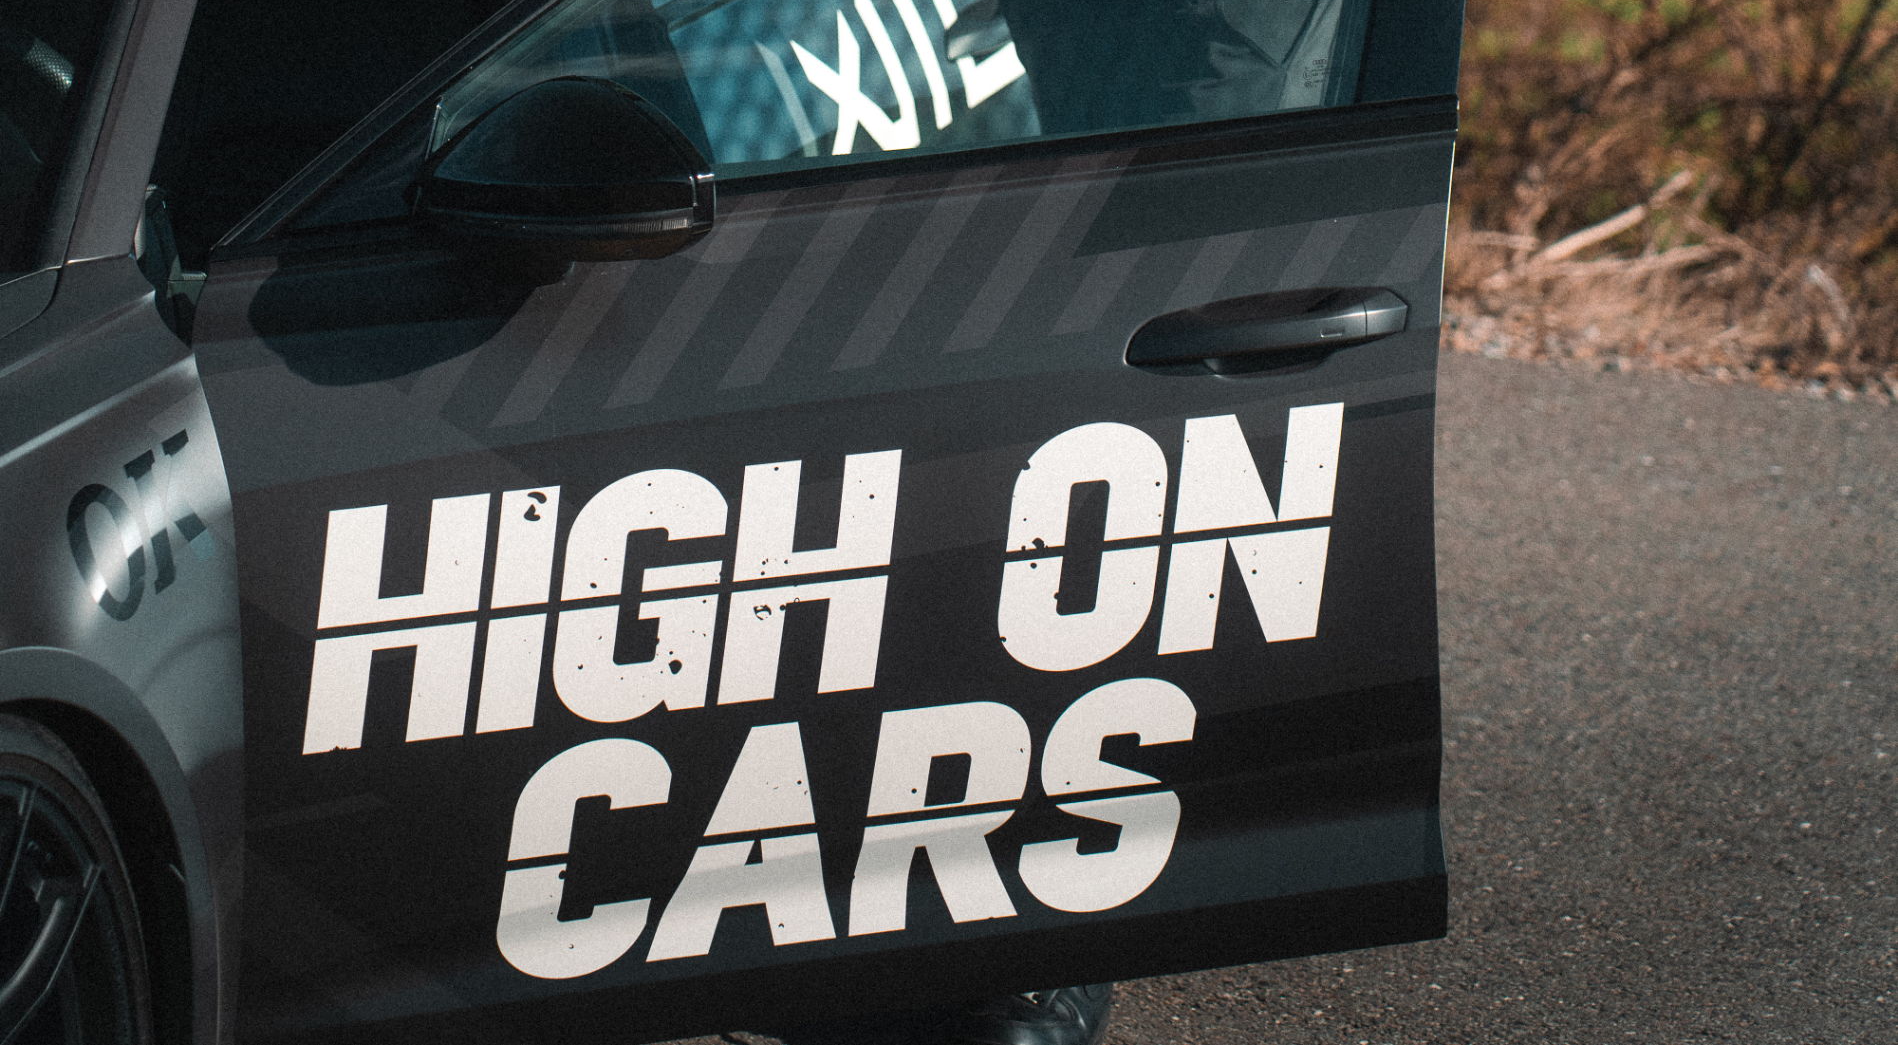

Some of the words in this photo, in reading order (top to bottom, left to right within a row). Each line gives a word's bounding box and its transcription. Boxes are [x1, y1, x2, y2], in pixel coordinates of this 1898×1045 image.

[303, 449, 902, 755] HIGH
[998, 402, 1344, 672] ON
[497, 678, 1197, 980] CARS
